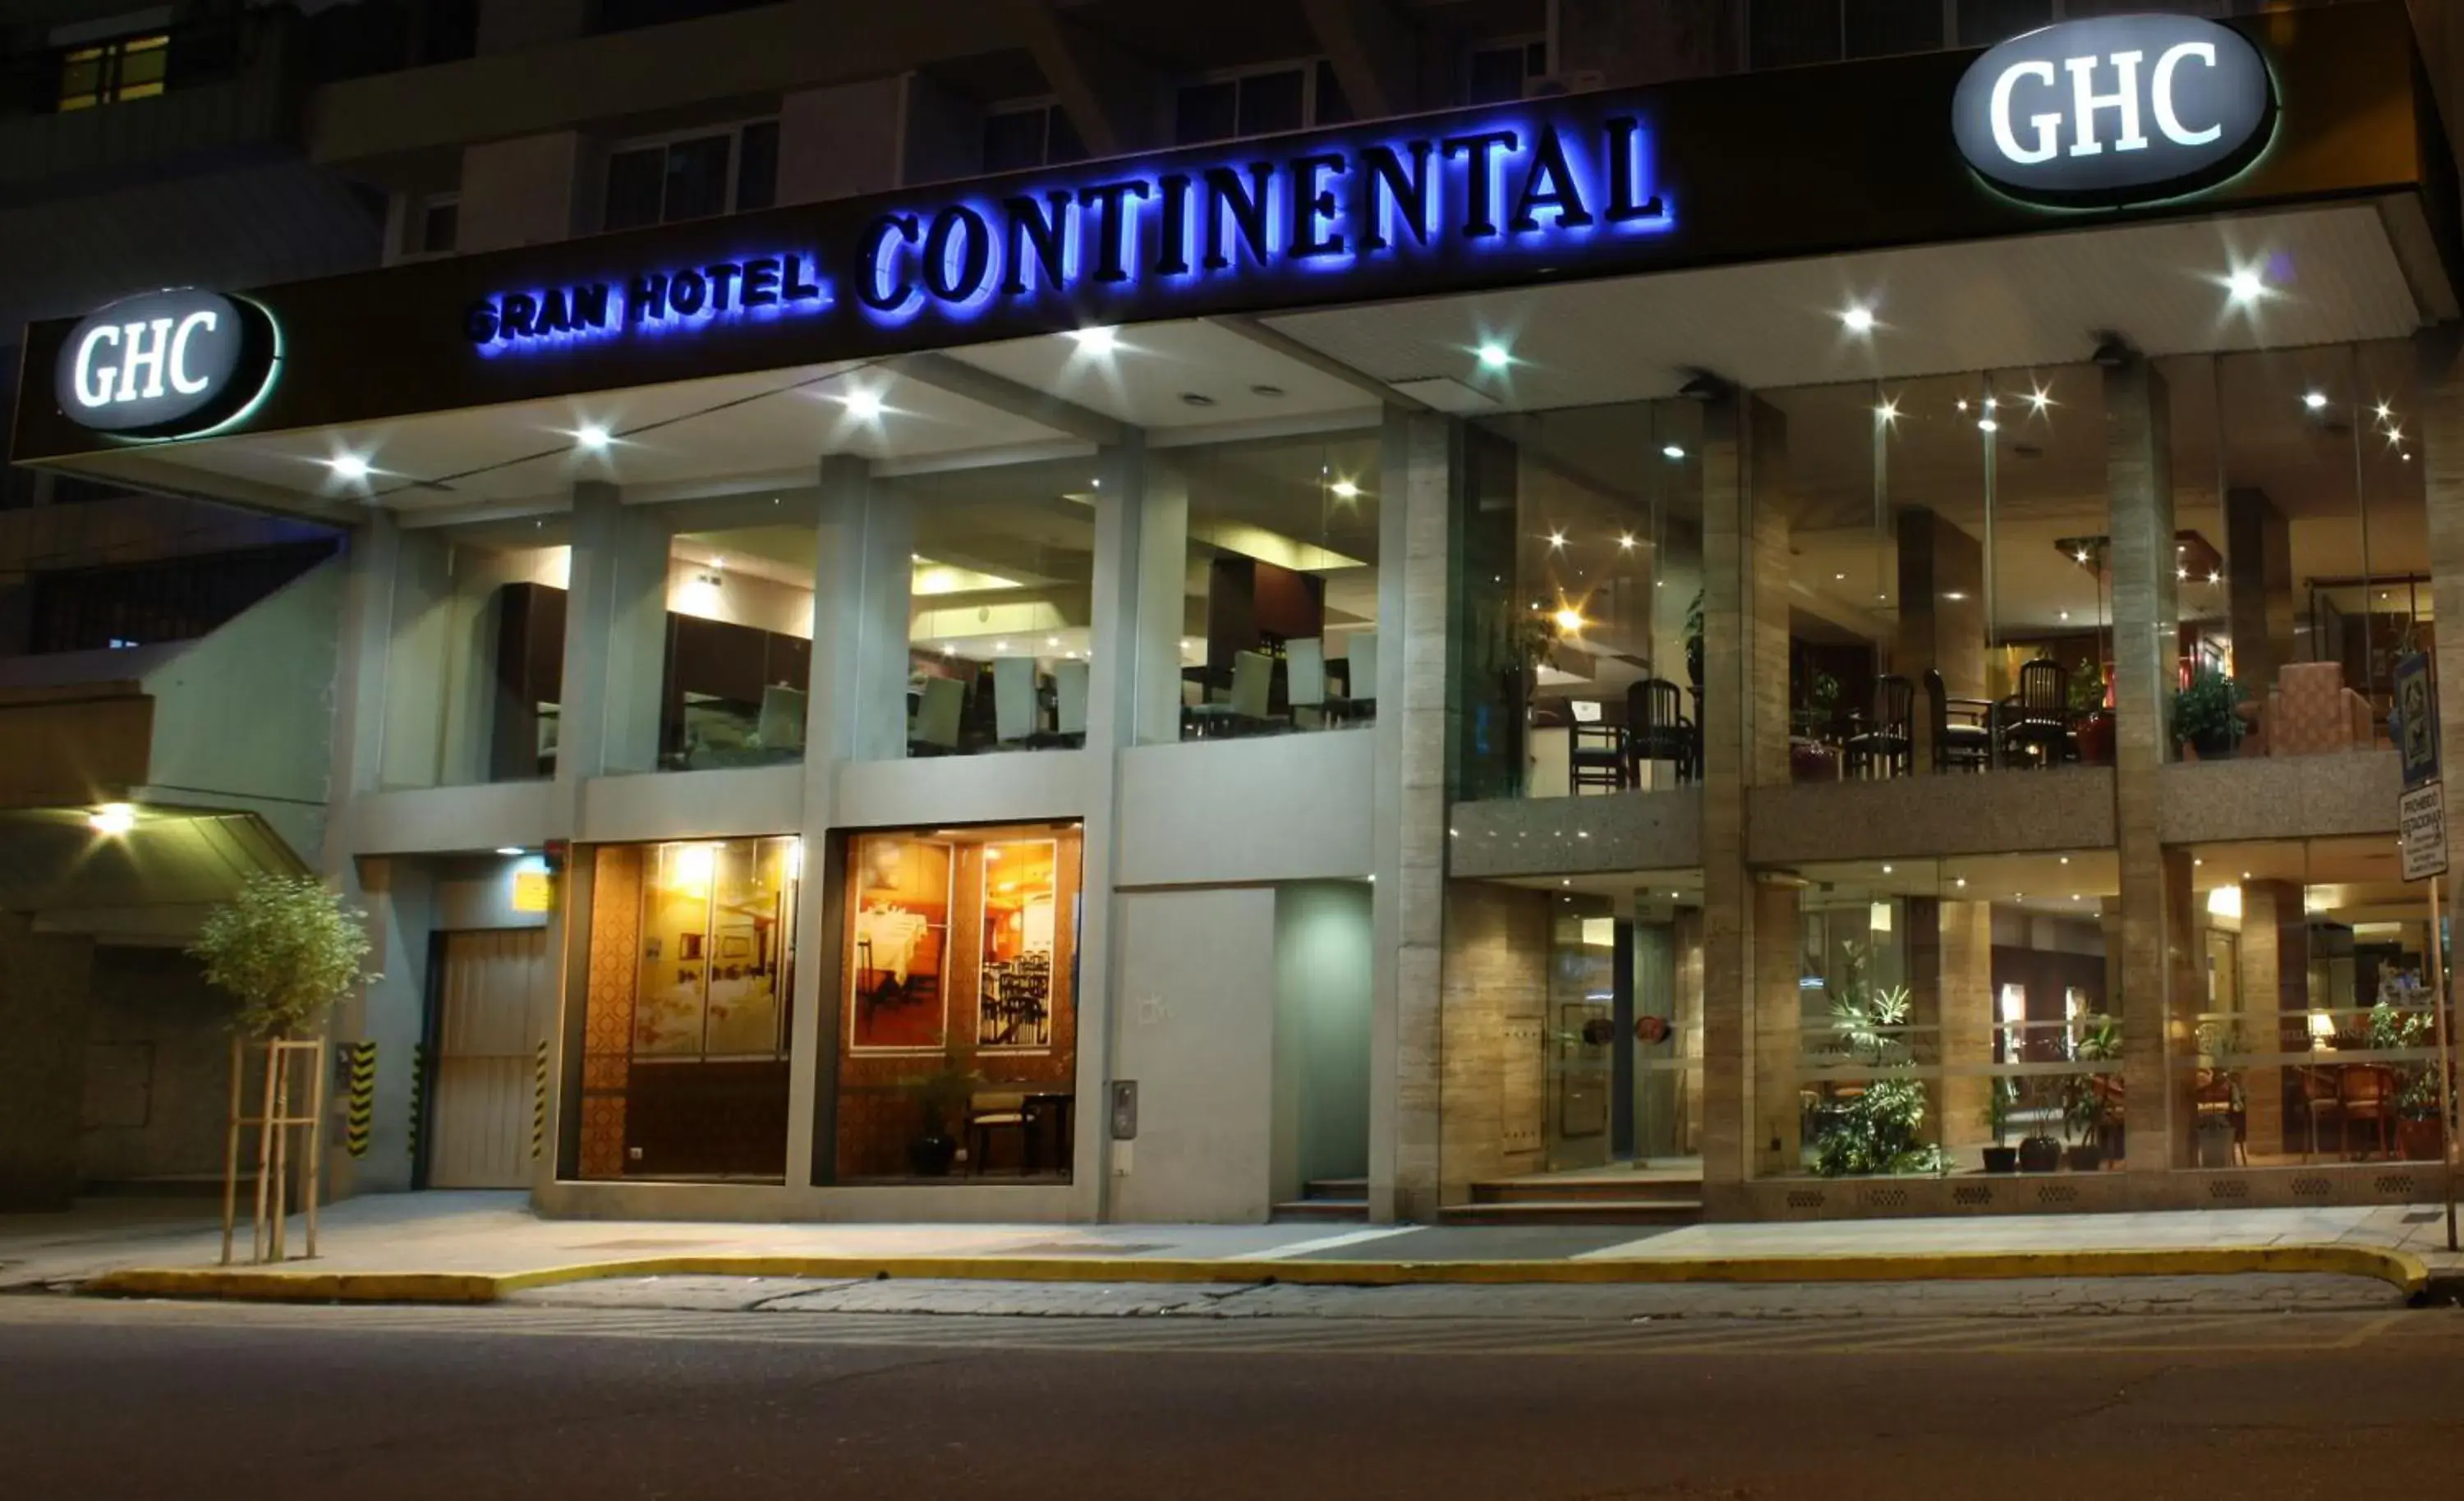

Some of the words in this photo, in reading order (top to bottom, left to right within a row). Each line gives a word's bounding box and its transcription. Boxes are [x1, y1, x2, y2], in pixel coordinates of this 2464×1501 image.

[1990, 42, 2222, 164] GHC
[463, 289, 609, 344] GRAN
[629, 255, 819, 322] HOTEL
[855, 116, 1663, 311] CONTINENTAL
[75, 311, 217, 408] GHC
